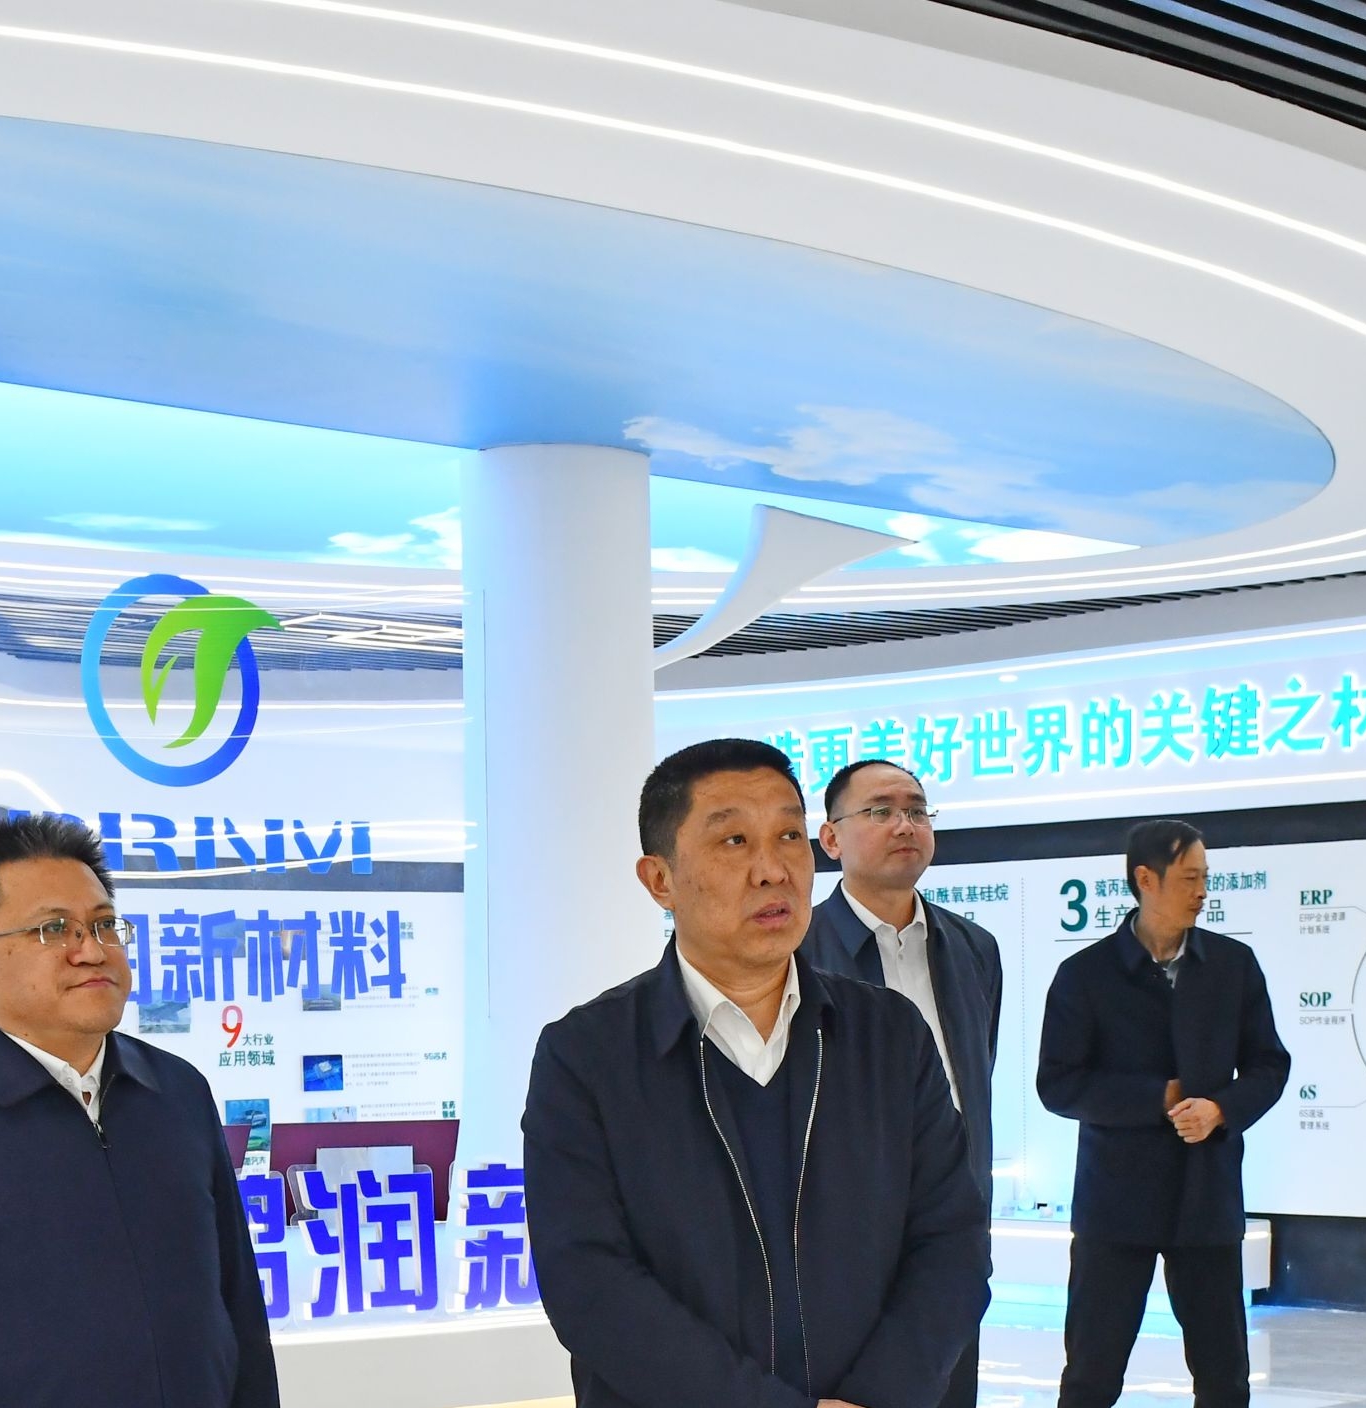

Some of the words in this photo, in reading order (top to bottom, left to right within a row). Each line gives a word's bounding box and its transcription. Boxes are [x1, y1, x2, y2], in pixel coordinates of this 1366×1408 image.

[1059, 879, 1089, 932] 3
[1300, 889, 1333, 906] ERP
[1300, 991, 1332, 1007] SOP
[221, 1005, 243, 1048] 9
[242, 1034, 274, 1046] 大行业
[219, 1049, 275, 1067] 应用领域
[1299, 1084, 1317, 1100] 6S
